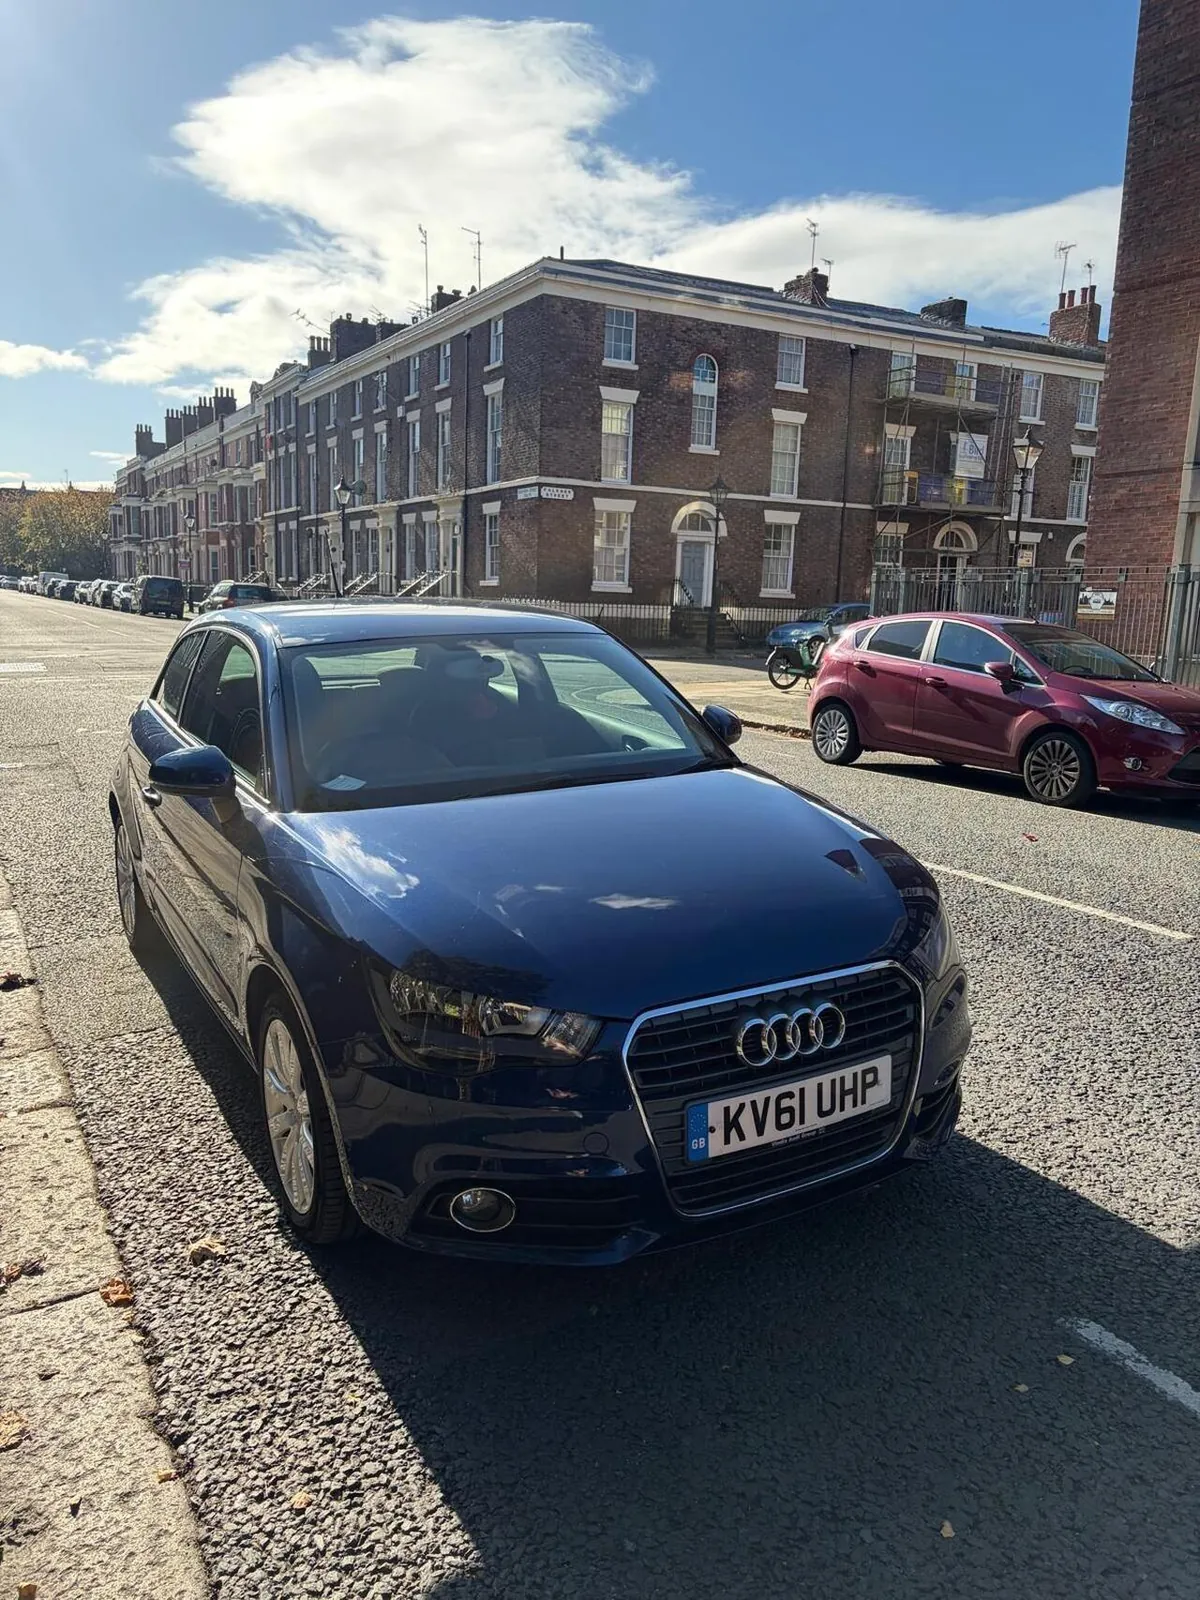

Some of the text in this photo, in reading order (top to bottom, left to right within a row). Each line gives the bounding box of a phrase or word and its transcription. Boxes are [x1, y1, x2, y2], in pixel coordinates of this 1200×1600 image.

[723, 1066, 879, 1146] KV61 UHP
[691, 1137, 706, 1150] GB
